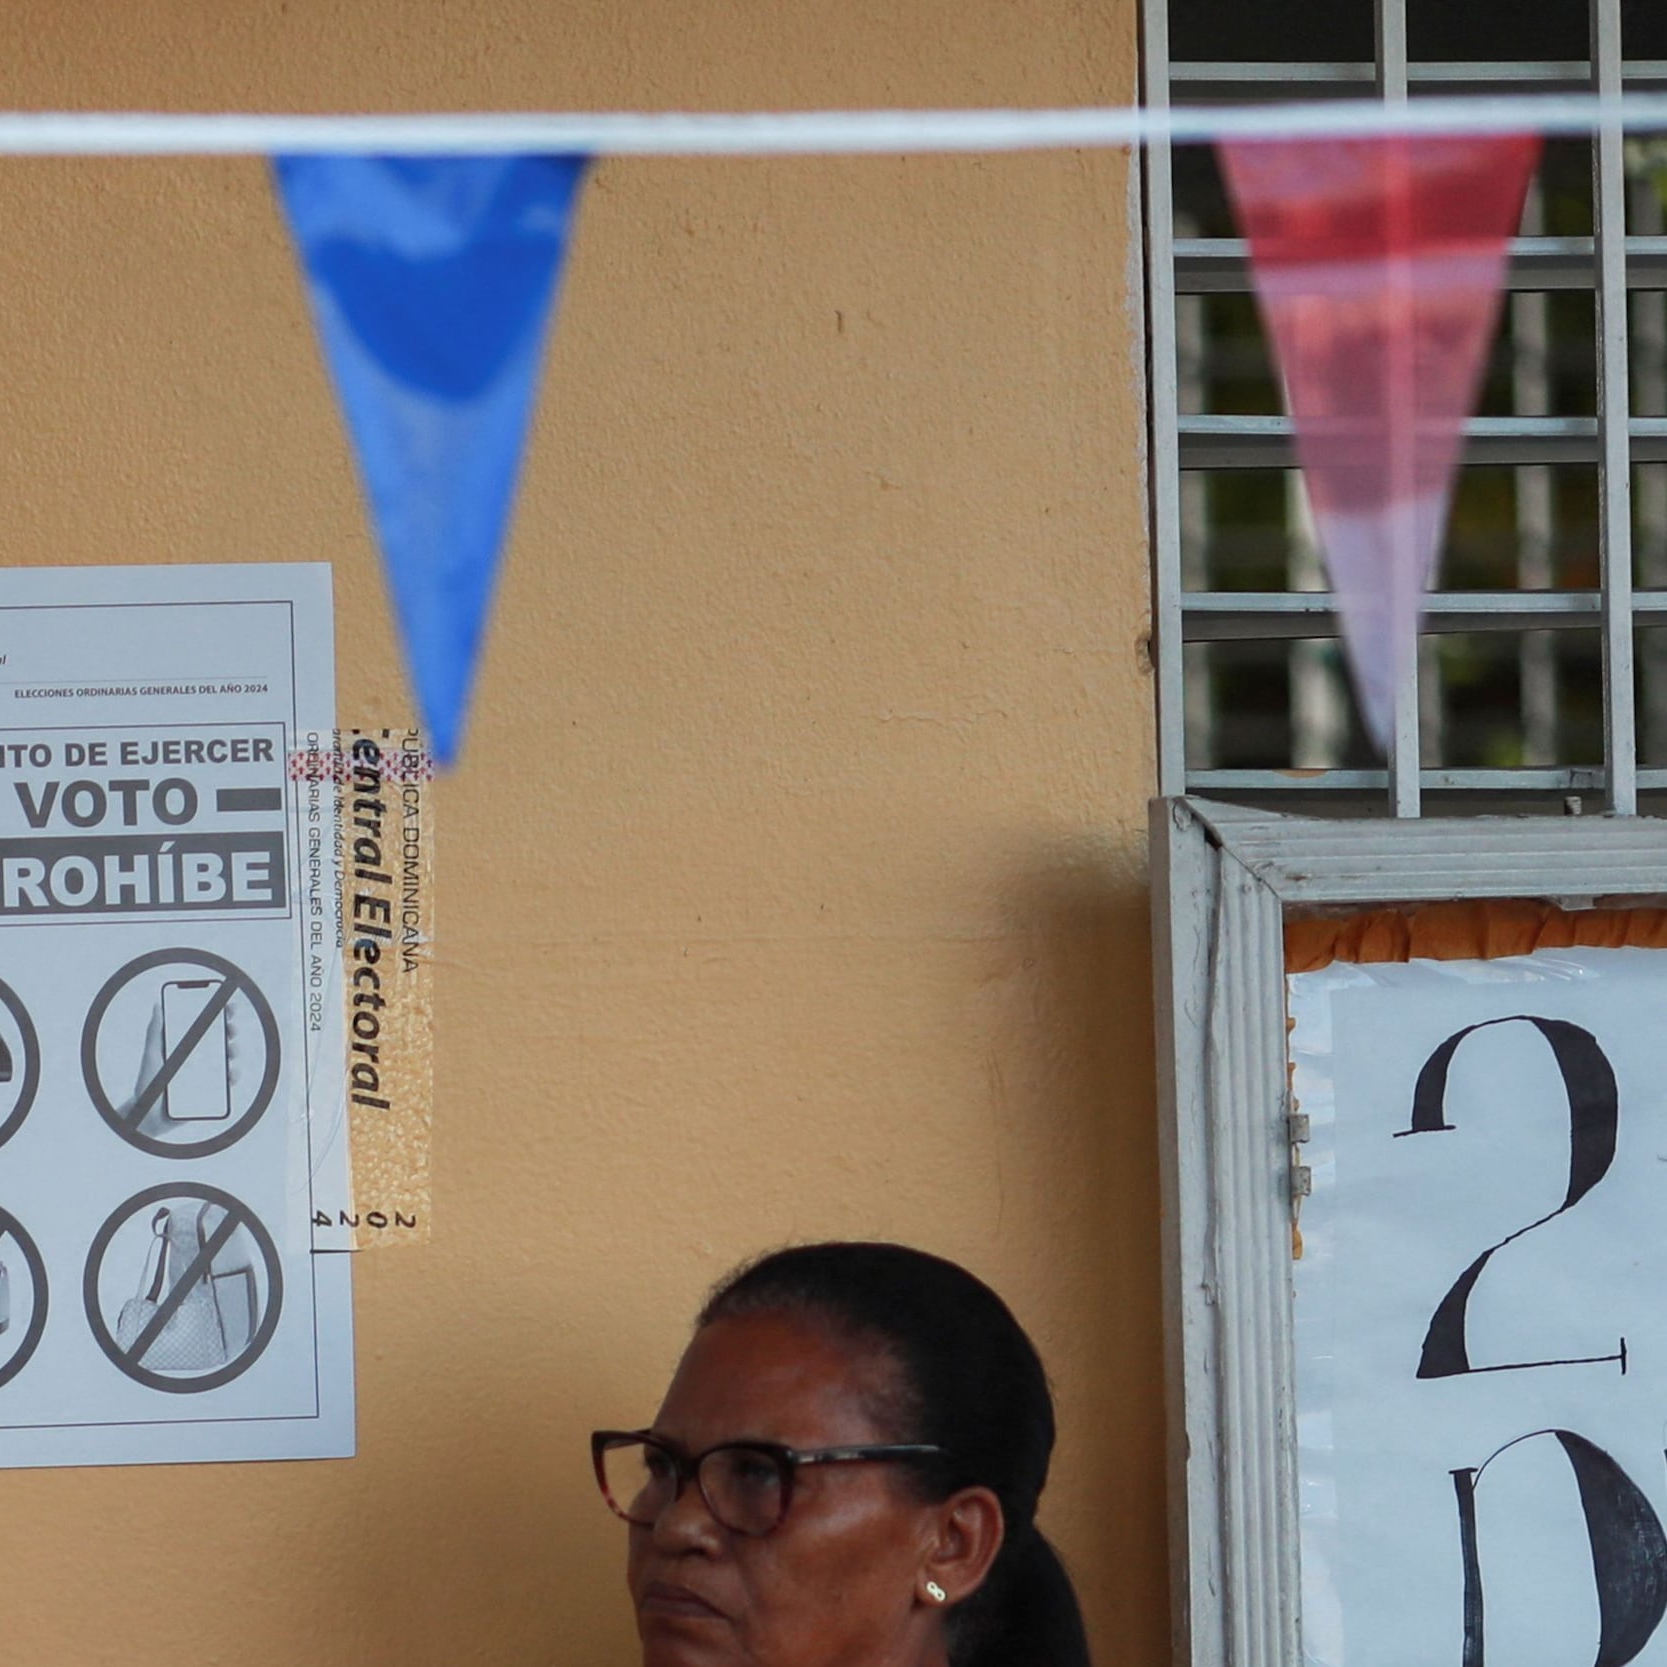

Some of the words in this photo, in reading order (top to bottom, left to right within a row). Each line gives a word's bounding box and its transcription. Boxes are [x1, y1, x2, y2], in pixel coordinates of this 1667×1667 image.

[14, 688, 74, 699] ELECCIONES
[76, 687, 138, 698] ORDINARIAS
[139, 685, 197, 696] GENERALES
[198, 685, 218, 695] DEL
[219, 682, 242, 694] AÑO
[243, 684, 269, 694] 2024
[65, 742, 109, 767] DE
[119, 738, 275, 766] EJERCER
[14, 776, 199, 831] VOTO
[351, 728, 393, 885] entral
[308, 826, 323, 917] GENERALES
[402, 826, 420, 974] DOMINICANA
[310, 920, 323, 951] DEL
[310, 955, 325, 989] AÑO
[309, 991, 323, 1033] 2024
[351, 892, 394, 1112] Electoral
[1393, 1015, 1628, 1380] 2
